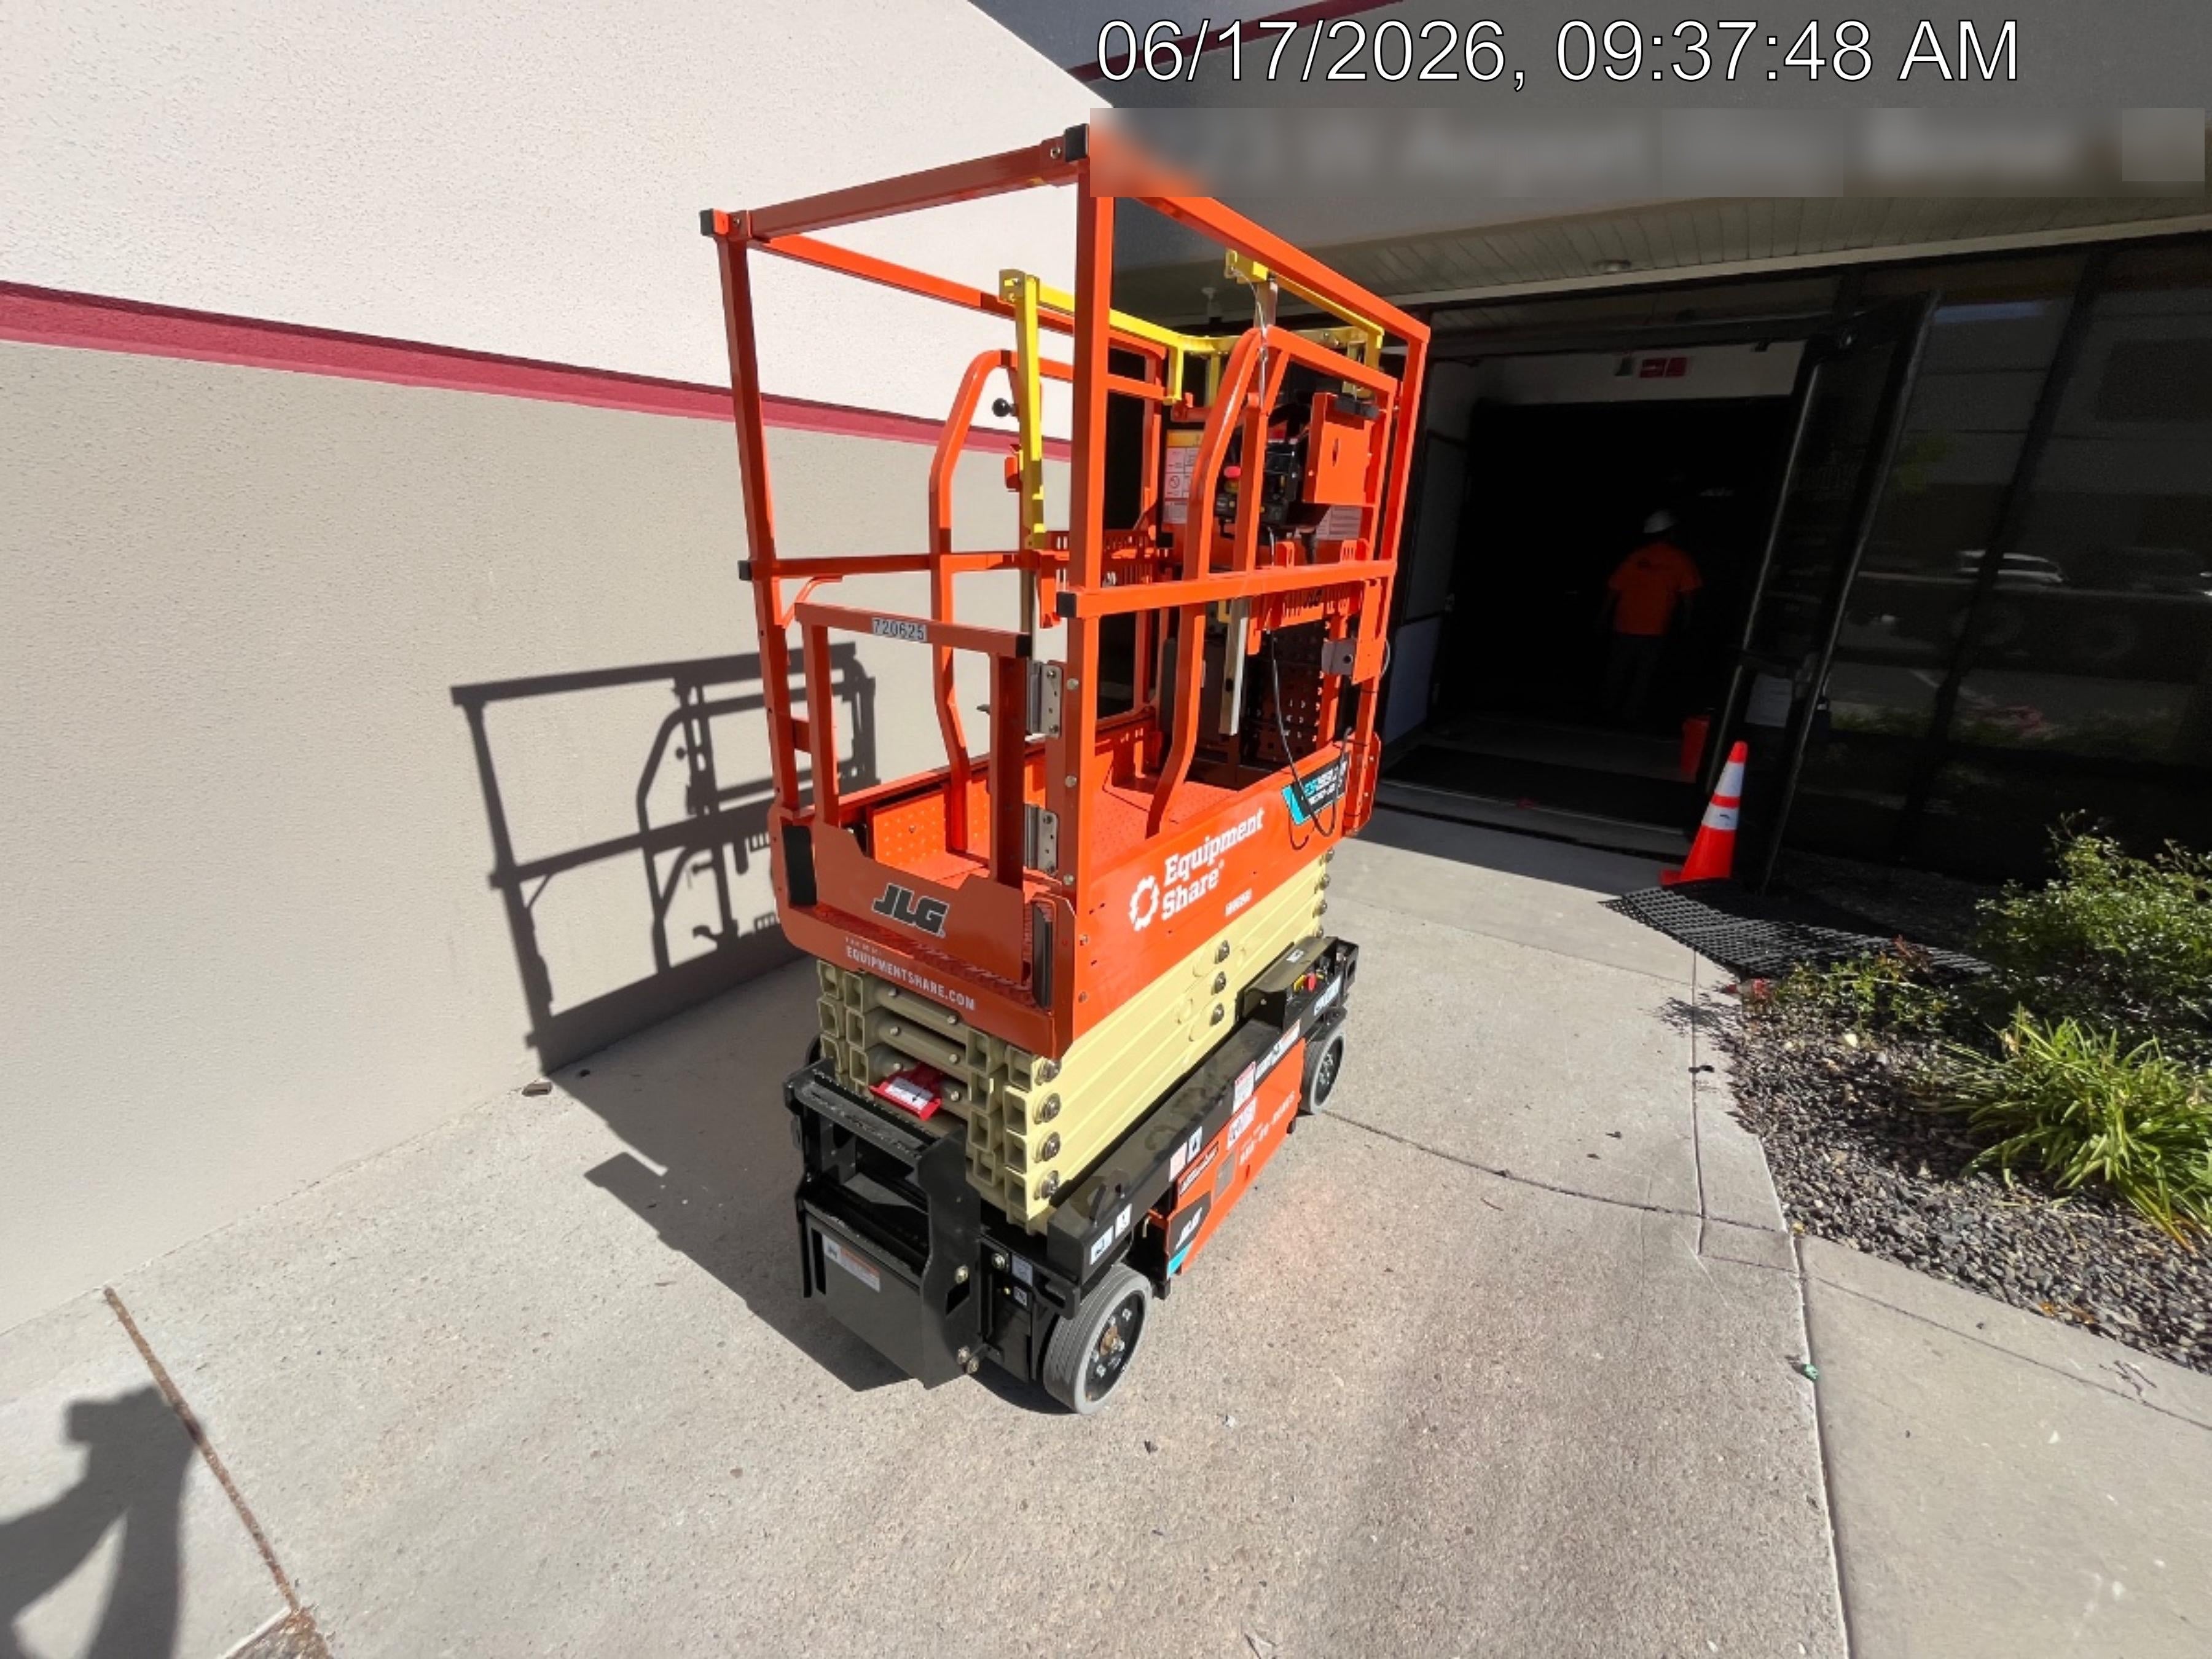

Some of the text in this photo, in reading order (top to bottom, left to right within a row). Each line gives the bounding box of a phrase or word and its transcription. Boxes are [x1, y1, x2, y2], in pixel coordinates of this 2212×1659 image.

[873, 619, 925, 640] 720625
[1164, 807, 1265, 887] Equipment
[871, 883, 950, 936] JLG
[845, 945, 975, 1011] EQUIPMENTSHARE.COM
